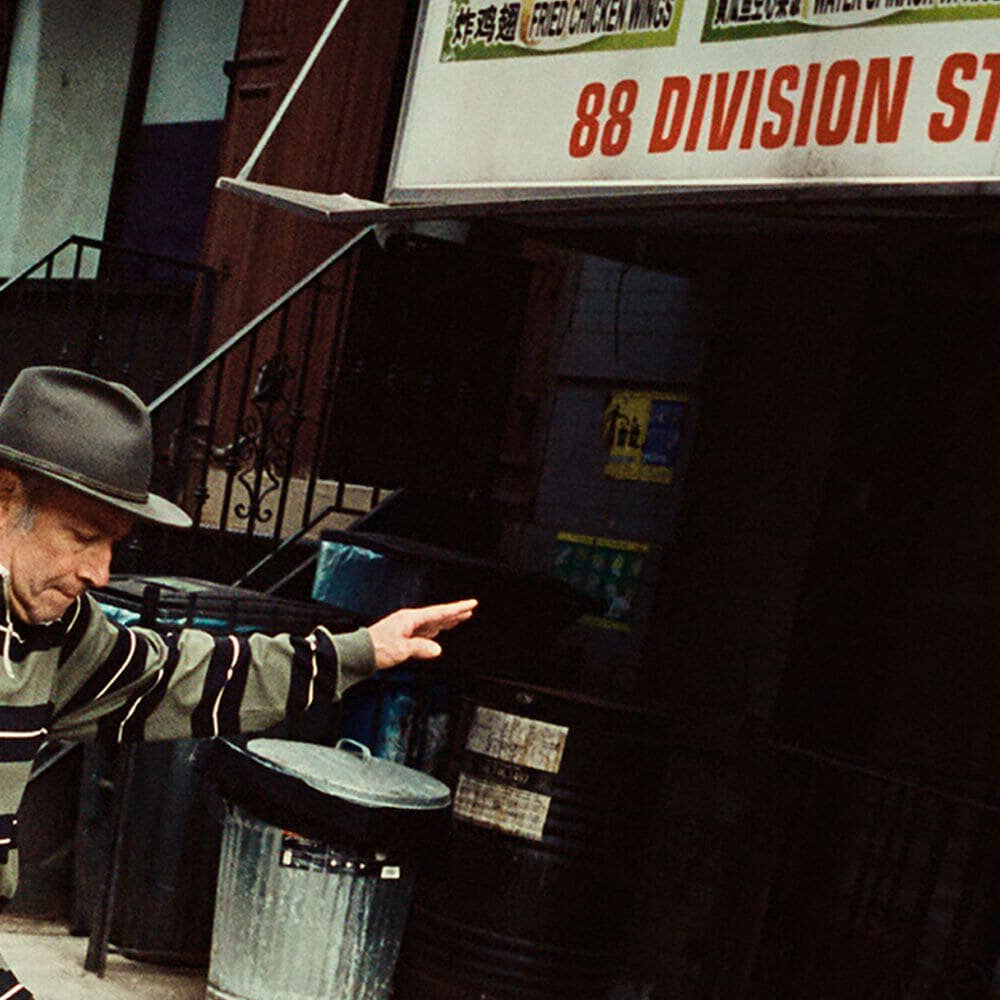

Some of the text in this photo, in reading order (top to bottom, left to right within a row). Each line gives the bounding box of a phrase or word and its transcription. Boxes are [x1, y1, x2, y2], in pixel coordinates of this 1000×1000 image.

[452, 3, 521, 44] 炸鸡翅
[529, 1, 568, 39] FRIED
[569, 0, 627, 35] CHICKEN
[628, 0, 674, 31] WINGS
[568, 51, 1000, 158] 88 DIVISION ST
